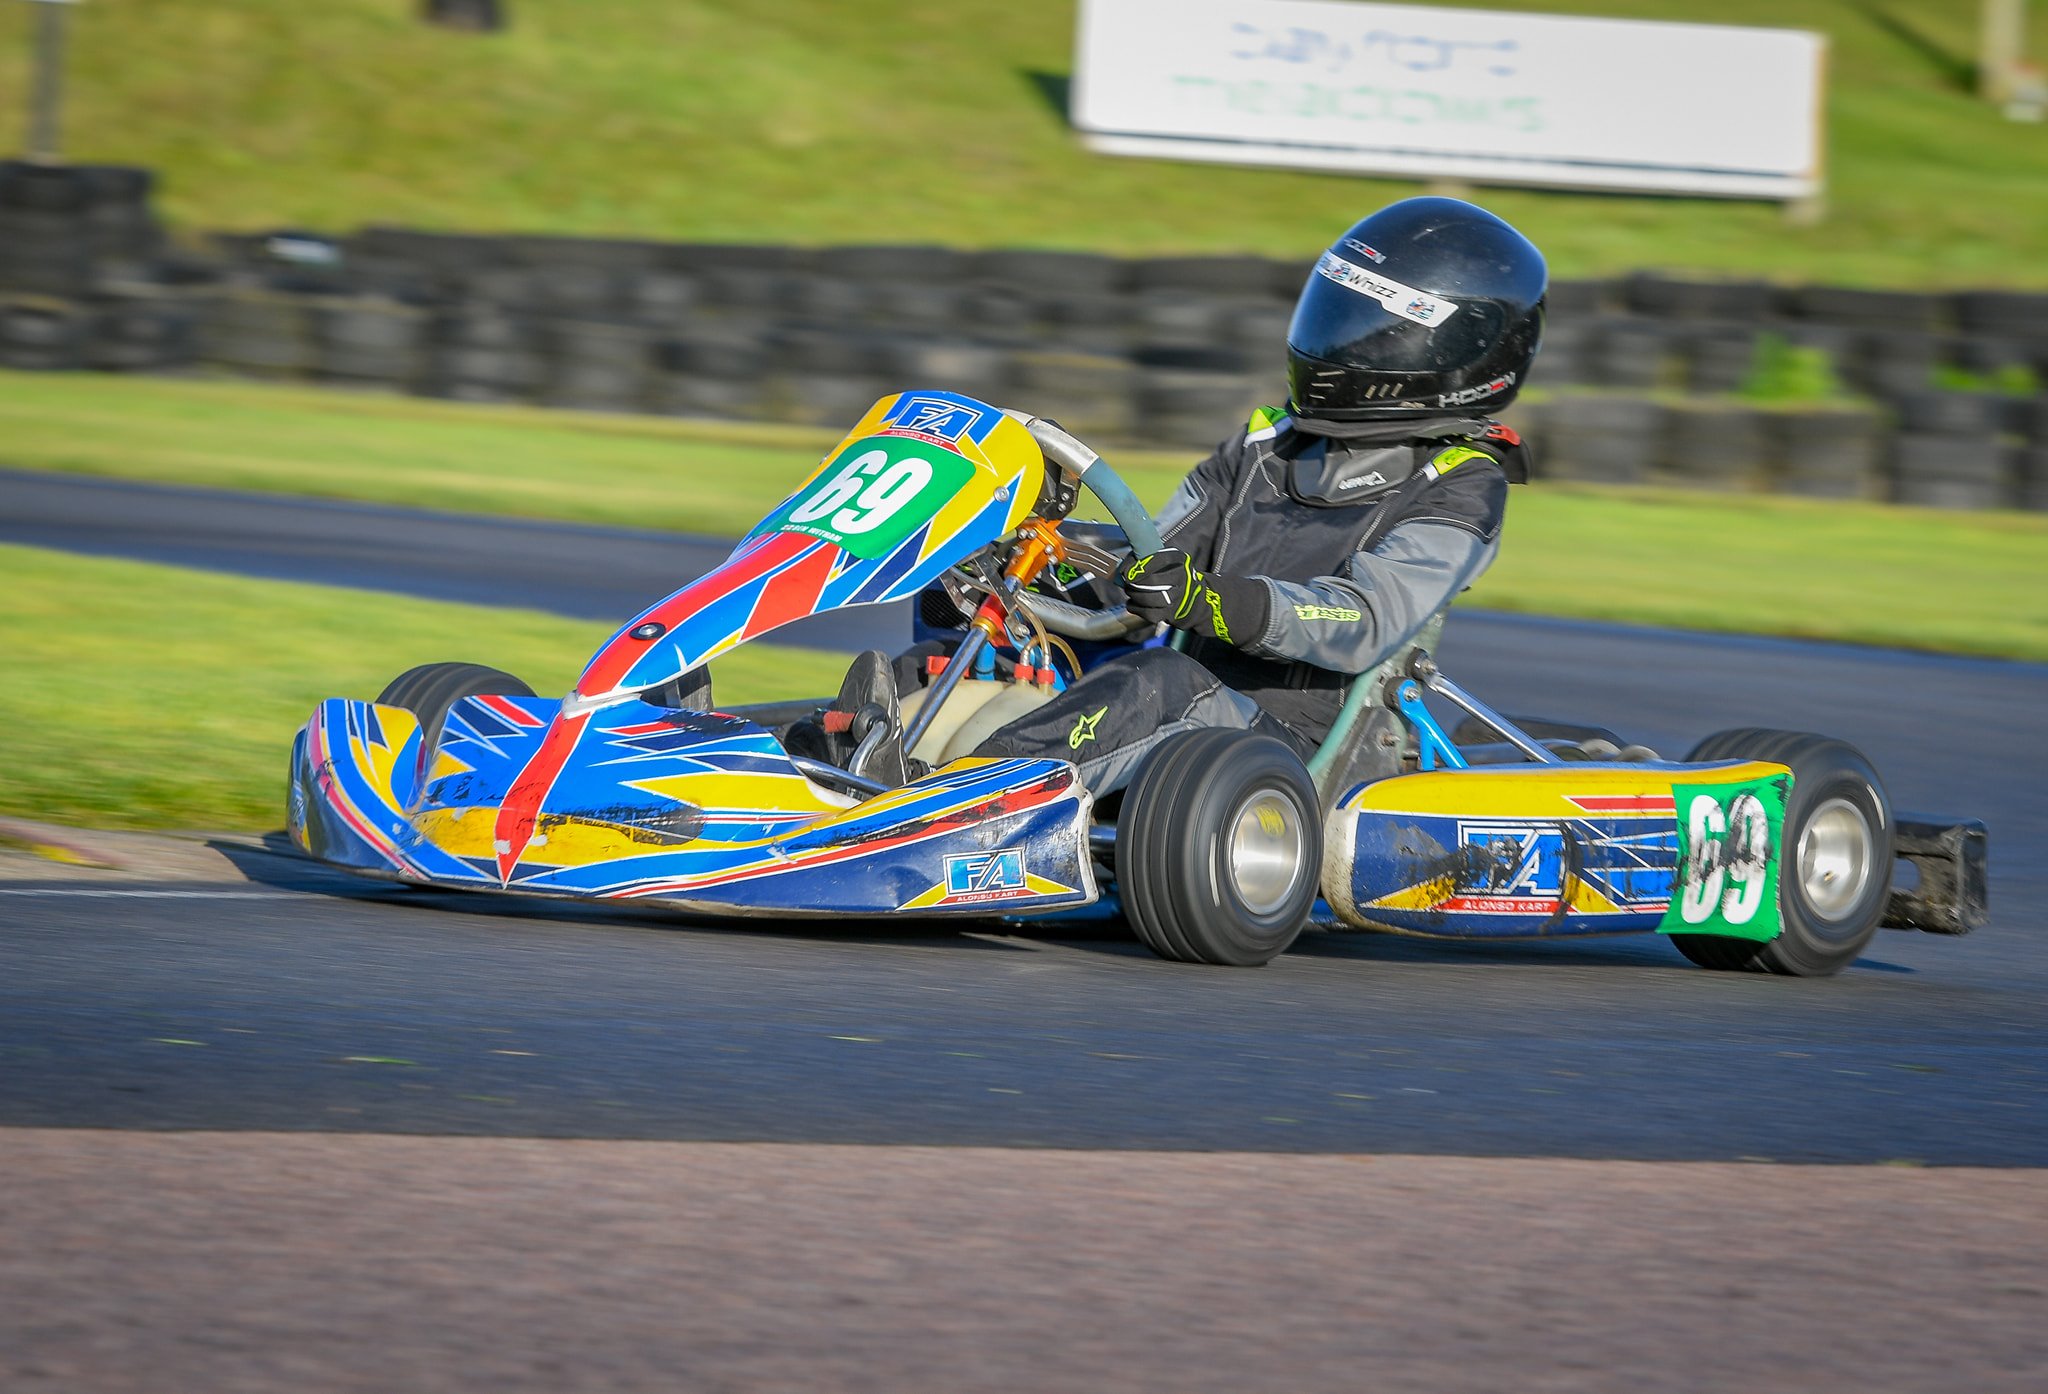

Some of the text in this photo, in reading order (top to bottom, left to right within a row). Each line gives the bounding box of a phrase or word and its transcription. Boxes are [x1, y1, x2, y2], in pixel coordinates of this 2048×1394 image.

[890, 430, 945, 447] ALONSO KART
[894, 398, 980, 441] FA
[788, 449, 934, 535] 69
[948, 851, 1024, 893] FA
[1680, 794, 1769, 925] 69
[957, 890, 1019, 903] ALONSO KART
[1462, 900, 1551, 912] ALONSO KART
